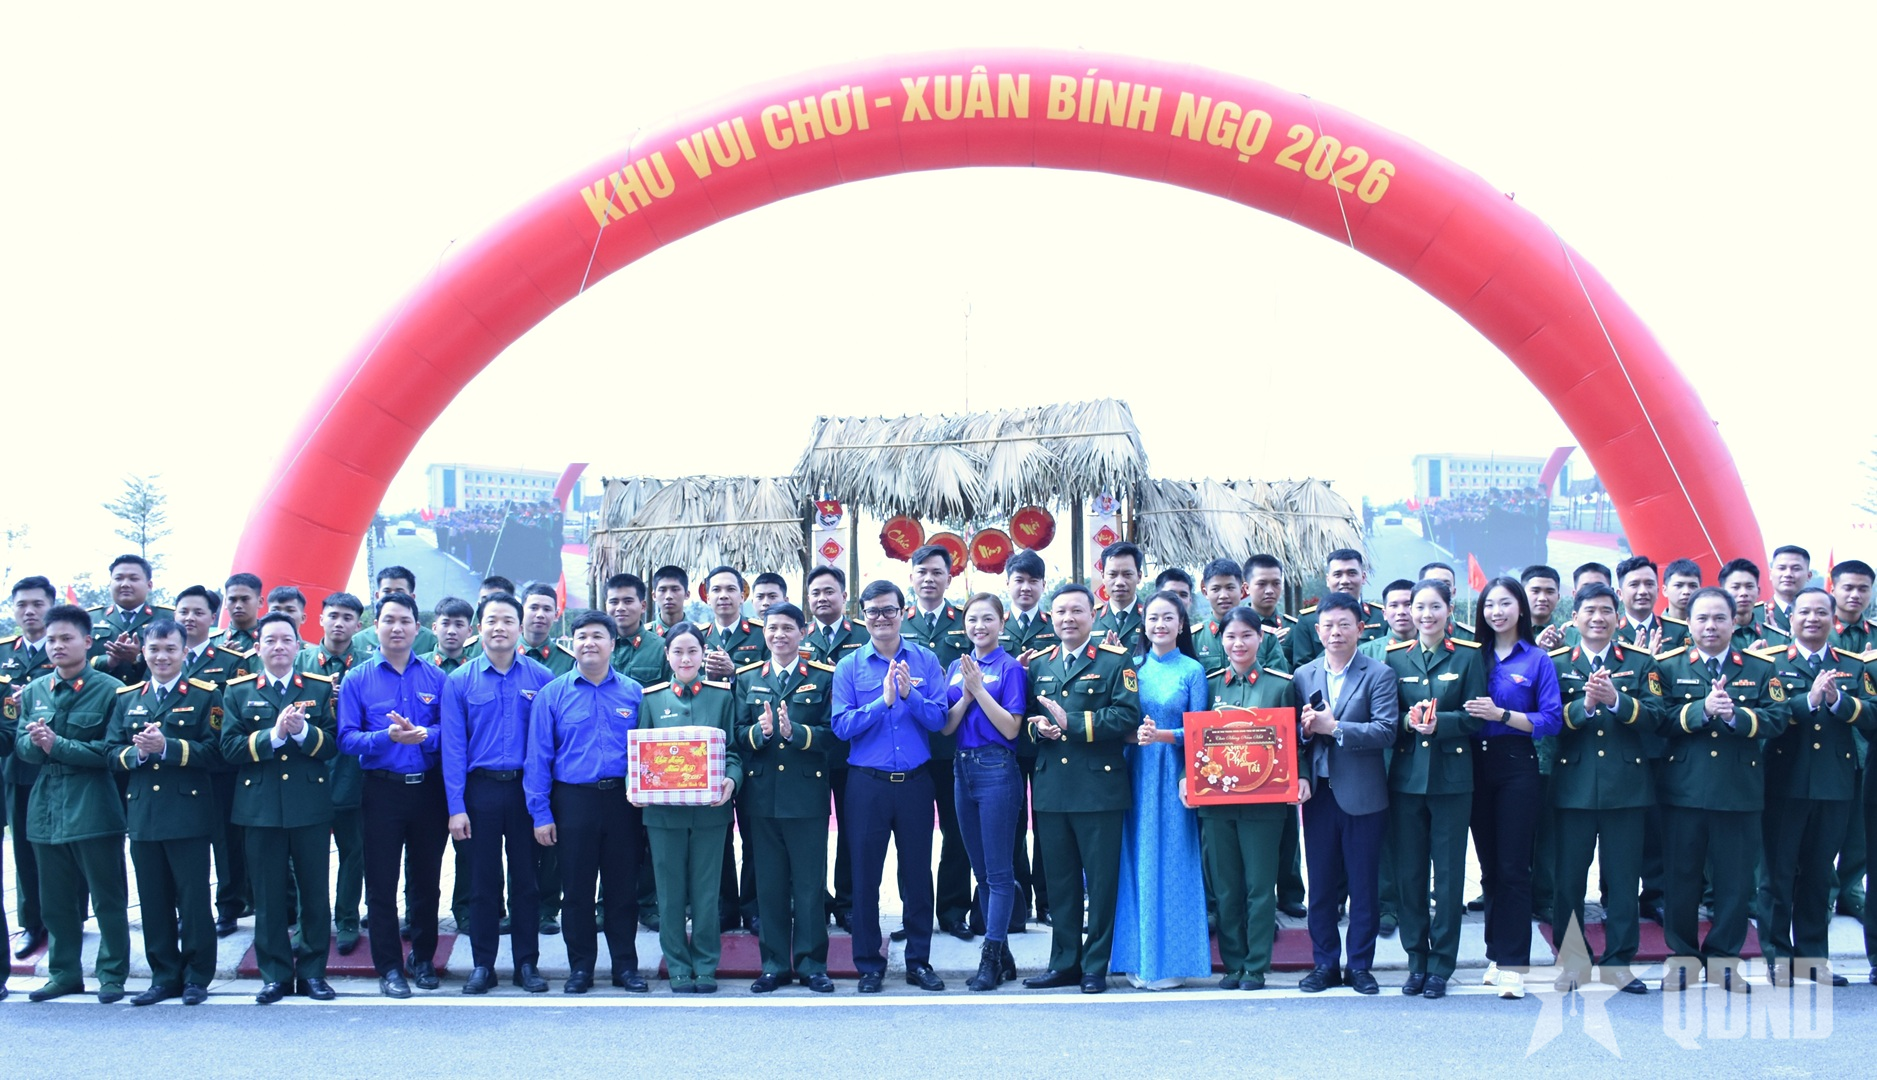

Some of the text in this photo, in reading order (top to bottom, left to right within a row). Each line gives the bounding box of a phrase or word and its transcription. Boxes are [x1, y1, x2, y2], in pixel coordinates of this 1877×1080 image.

[579, 151, 676, 229] KHU
[675, 116, 757, 180] VUI
[760, 84, 870, 150] CHƠI
[900, 65, 1030, 122] XUÂN
[1046, 68, 1162, 132] BÍNH
[1170, 91, 1273, 163] NGỌ
[1274, 124, 1396, 204] 2026
